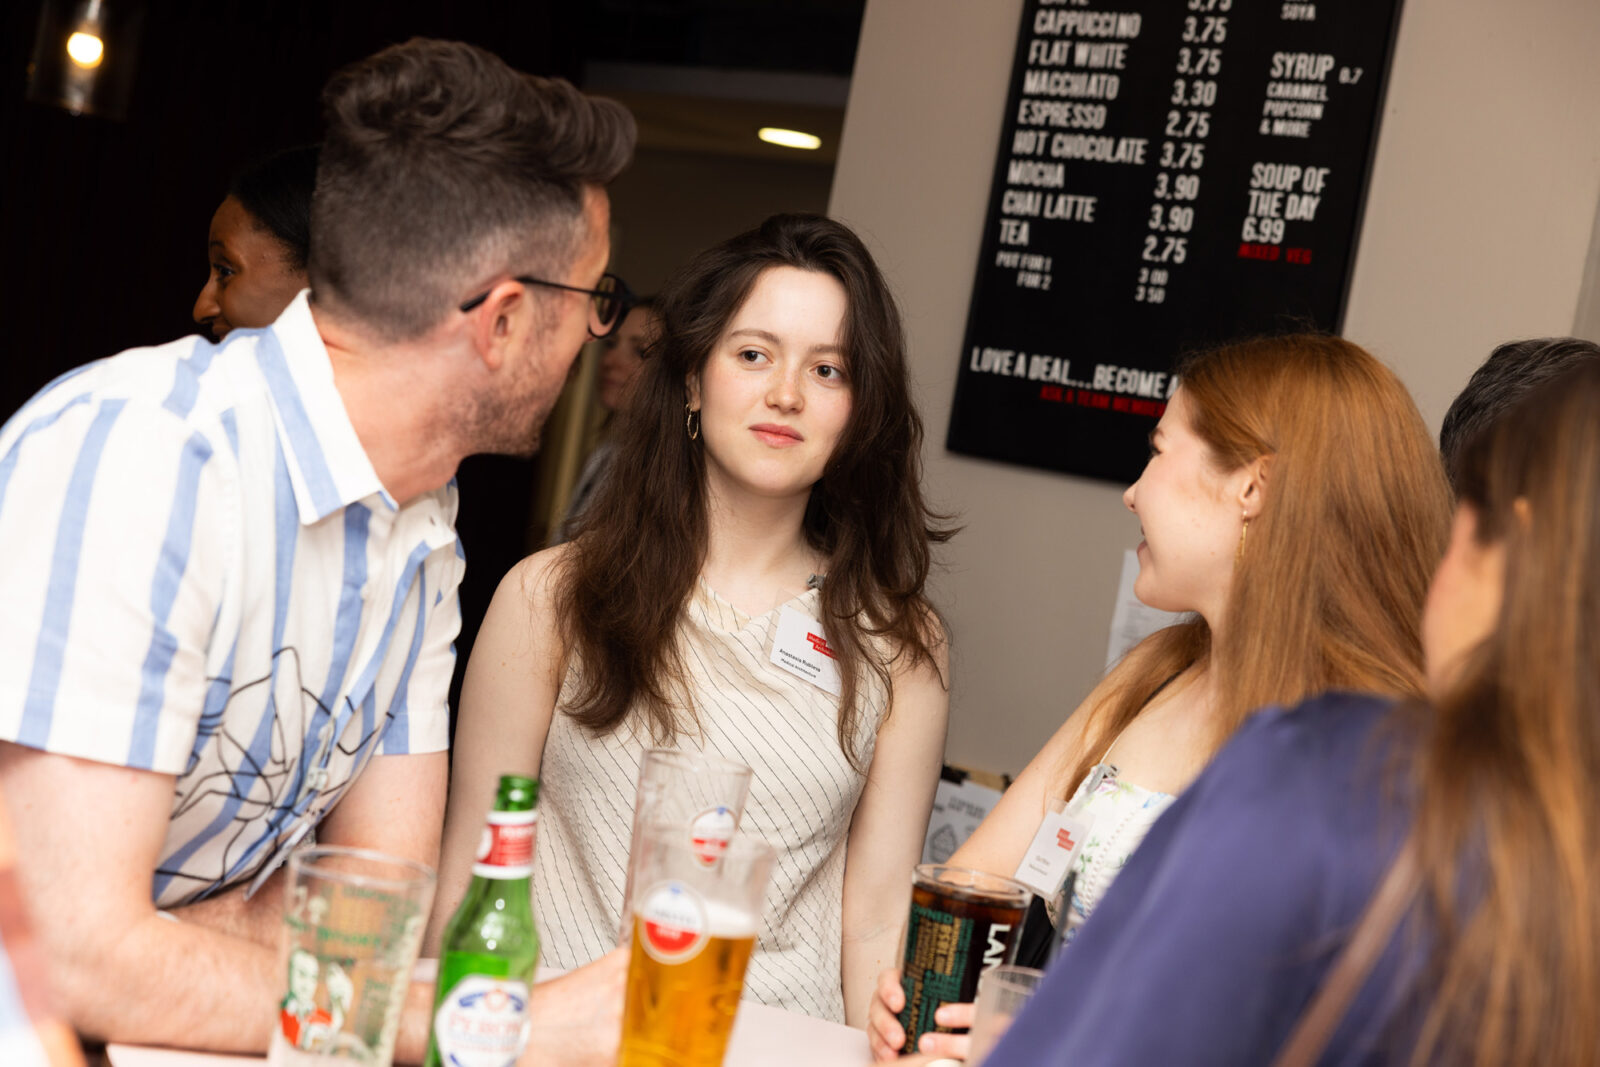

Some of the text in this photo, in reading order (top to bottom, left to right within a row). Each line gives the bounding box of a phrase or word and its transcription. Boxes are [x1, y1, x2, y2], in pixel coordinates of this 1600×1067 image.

[1033, 9, 1142, 38] CAPPUCCINO
[1281, 3, 1316, 20] SOYA
[1182, 15, 1228, 43] 3.75
[1028, 40, 1129, 69] FLAT WHITE
[1176, 47, 1222, 75] 3.75
[1270, 51, 1335, 82] SYRUP
[1023, 69, 1120, 100] MACCHIATO
[1171, 78, 1217, 107] 3.30
[1266, 81, 1328, 101] CARAMEL
[1017, 99, 1107, 129] ESPRESSO
[1165, 109, 1211, 138] 2.75
[1262, 99, 1324, 120] POPCORN
[1259, 118, 1312, 138] & MORE
[1012, 129, 1149, 165] HOT CHOCOLATE
[1160, 141, 1205, 169] 3.75
[1007, 159, 1065, 188] MOCHA
[1153, 172, 1200, 200] 3.90
[1249, 161, 1331, 194] SOUP OF
[1001, 189, 1098, 223] CHAI LATTE
[1148, 203, 1194, 233] 3.90
[1248, 189, 1321, 222] THE DAY
[1000, 218, 1029, 246] TEA
[1241, 216, 1285, 245] 6.99
[1142, 234, 1188, 264] 2.75
[1286, 247, 1312, 265] VEG
[1041, 274, 1052, 291] 2
[969, 346, 1015, 376] LOVE
[1013, 351, 1027, 378] A
